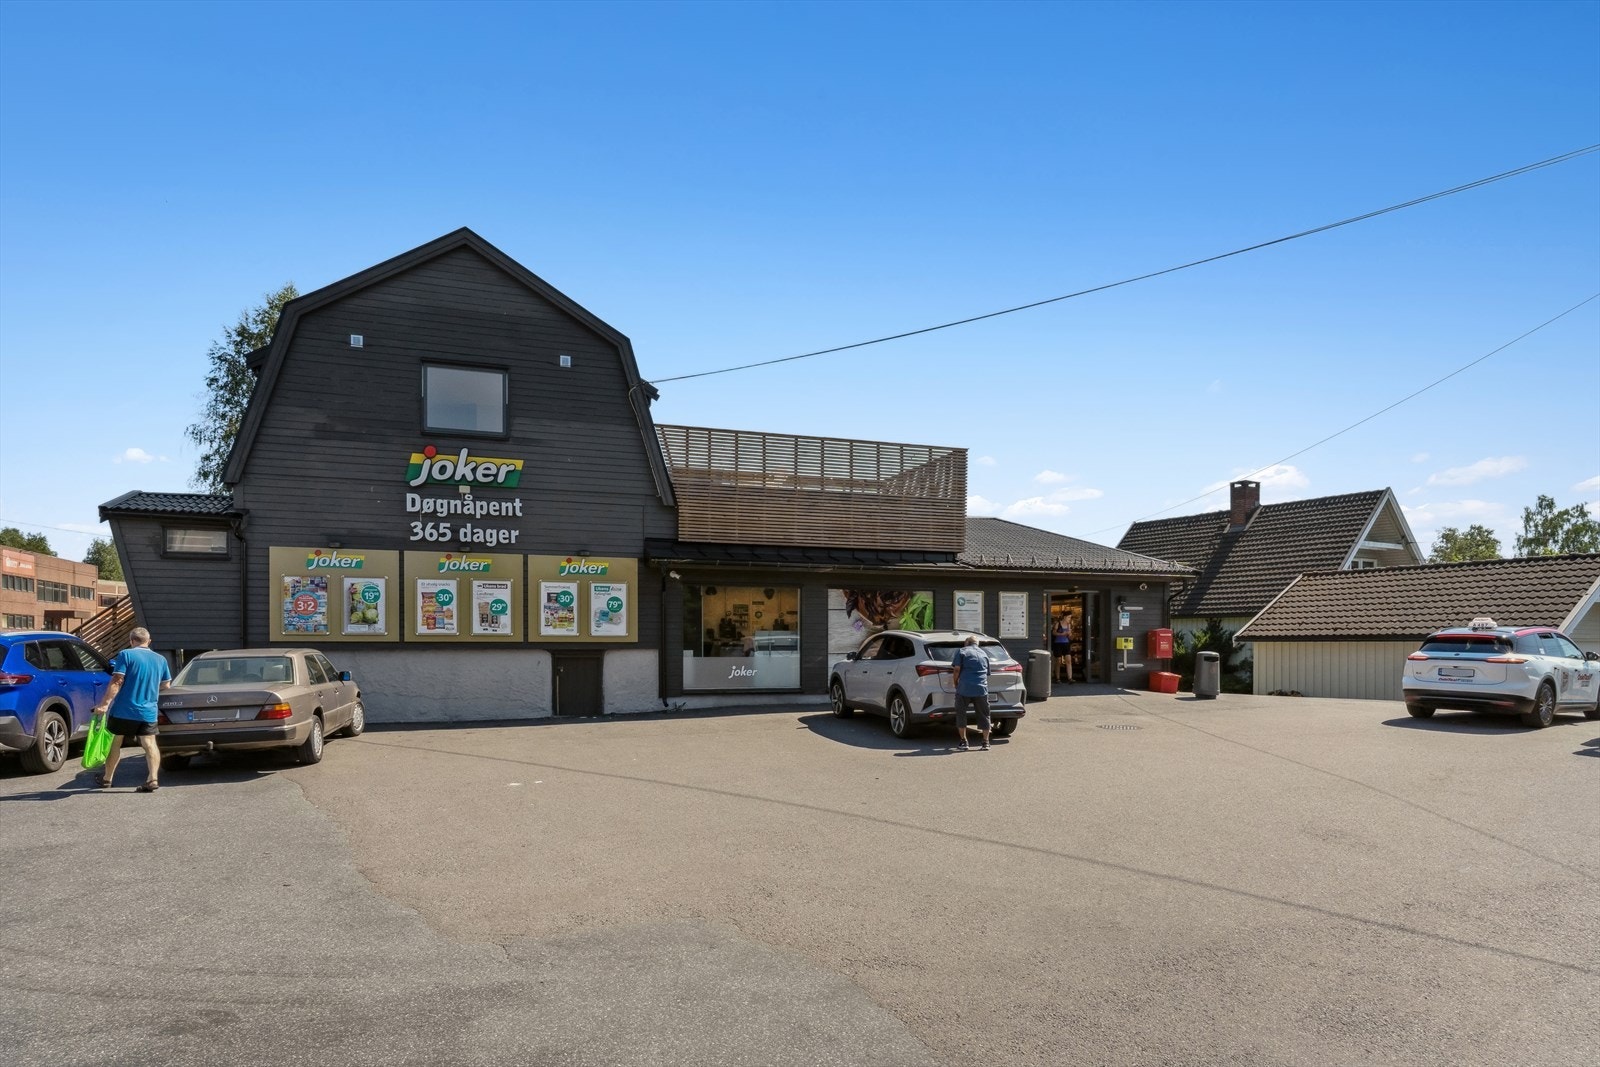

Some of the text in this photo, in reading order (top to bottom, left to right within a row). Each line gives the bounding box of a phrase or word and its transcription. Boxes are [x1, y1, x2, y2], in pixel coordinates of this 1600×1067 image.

[409, 445, 516, 487] joker
[406, 493, 523, 519] Døgnåpent
[410, 521, 519, 547] 365 dager
[308, 549, 361, 570] joker
[439, 553, 488, 573] joker
[560, 557, 605, 577] joker
[728, 666, 758, 679] joker
